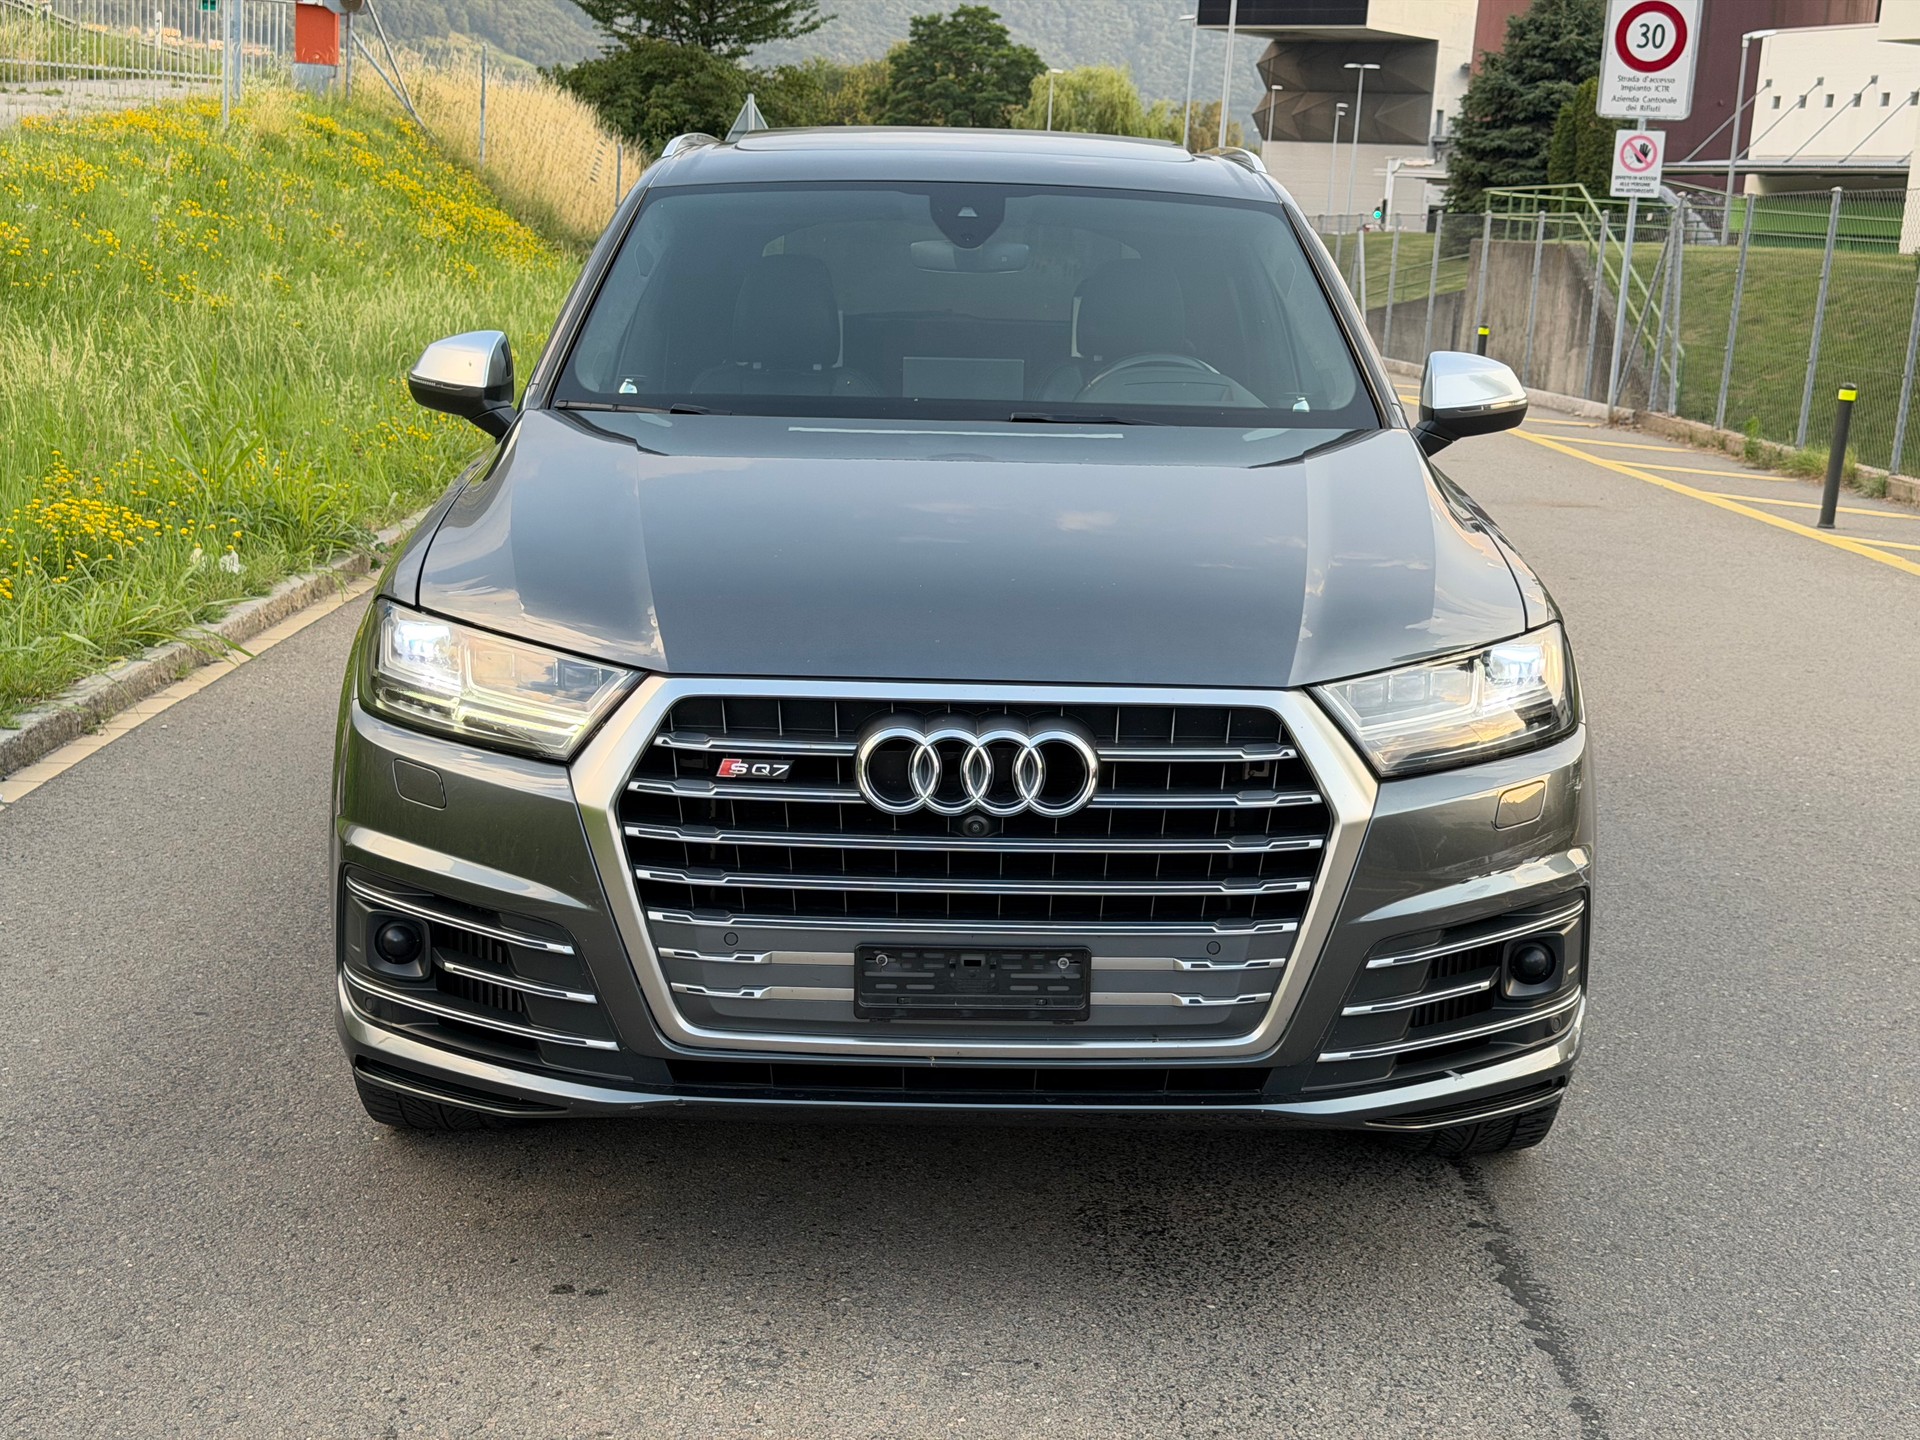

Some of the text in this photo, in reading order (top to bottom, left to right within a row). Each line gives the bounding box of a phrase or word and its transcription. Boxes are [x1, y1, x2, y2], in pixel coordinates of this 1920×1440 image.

[1636, 23, 1666, 49] 30
[1617, 75, 1640, 83] Strada
[1621, 84, 1651, 92] Impianto
[1611, 94, 1677, 104] Azienda Cantonale
[1626, 104, 1637, 112] dei
[728, 762, 790, 777] SQ7
